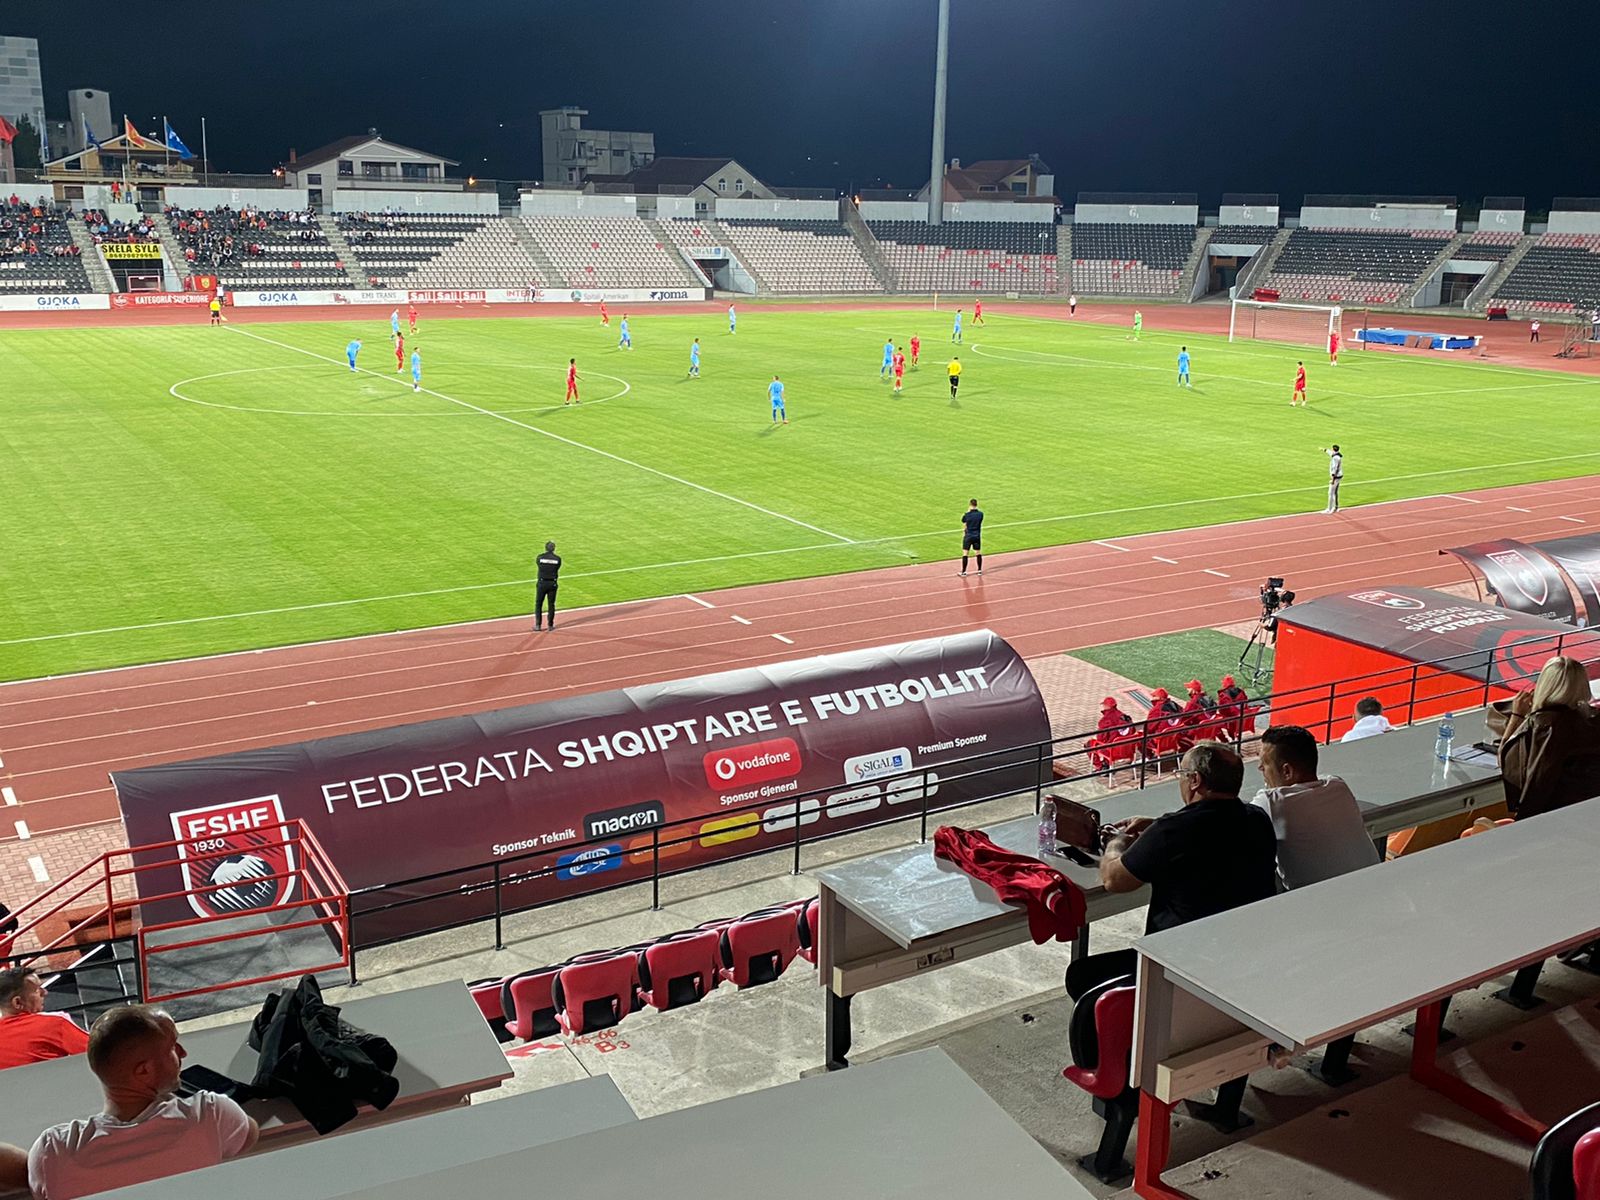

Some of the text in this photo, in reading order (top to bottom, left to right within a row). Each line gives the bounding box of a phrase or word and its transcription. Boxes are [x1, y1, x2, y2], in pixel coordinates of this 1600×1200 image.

[101, 244, 159, 254] SKELA SYLA
[37, 297, 80, 306] GJOKA
[135, 295, 171, 305] KATEGORIA
[171, 294, 209, 304] SUPERIORE
[258, 293, 298, 302] GJOKA
[506, 289, 545, 298] INTERIG
[1398, 606, 1477, 624] FEDERATA
[1430, 613, 1512, 634] FUTBOLLIT
[321, 666, 989, 814] FEDERATA SHQIPTARE E FUTBOLLIT
[917, 733, 988, 756] Premium Sponsor
[737, 751, 791, 771] vodafone
[863, 757, 893, 772] SIGAL
[720, 780, 798, 806] Sponsor Gjeneral
[187, 806, 269, 839] FSHF
[590, 809, 658, 836] macron
[192, 837, 225, 853] 1930
[492, 828, 576, 856] Sponsor Teknik
